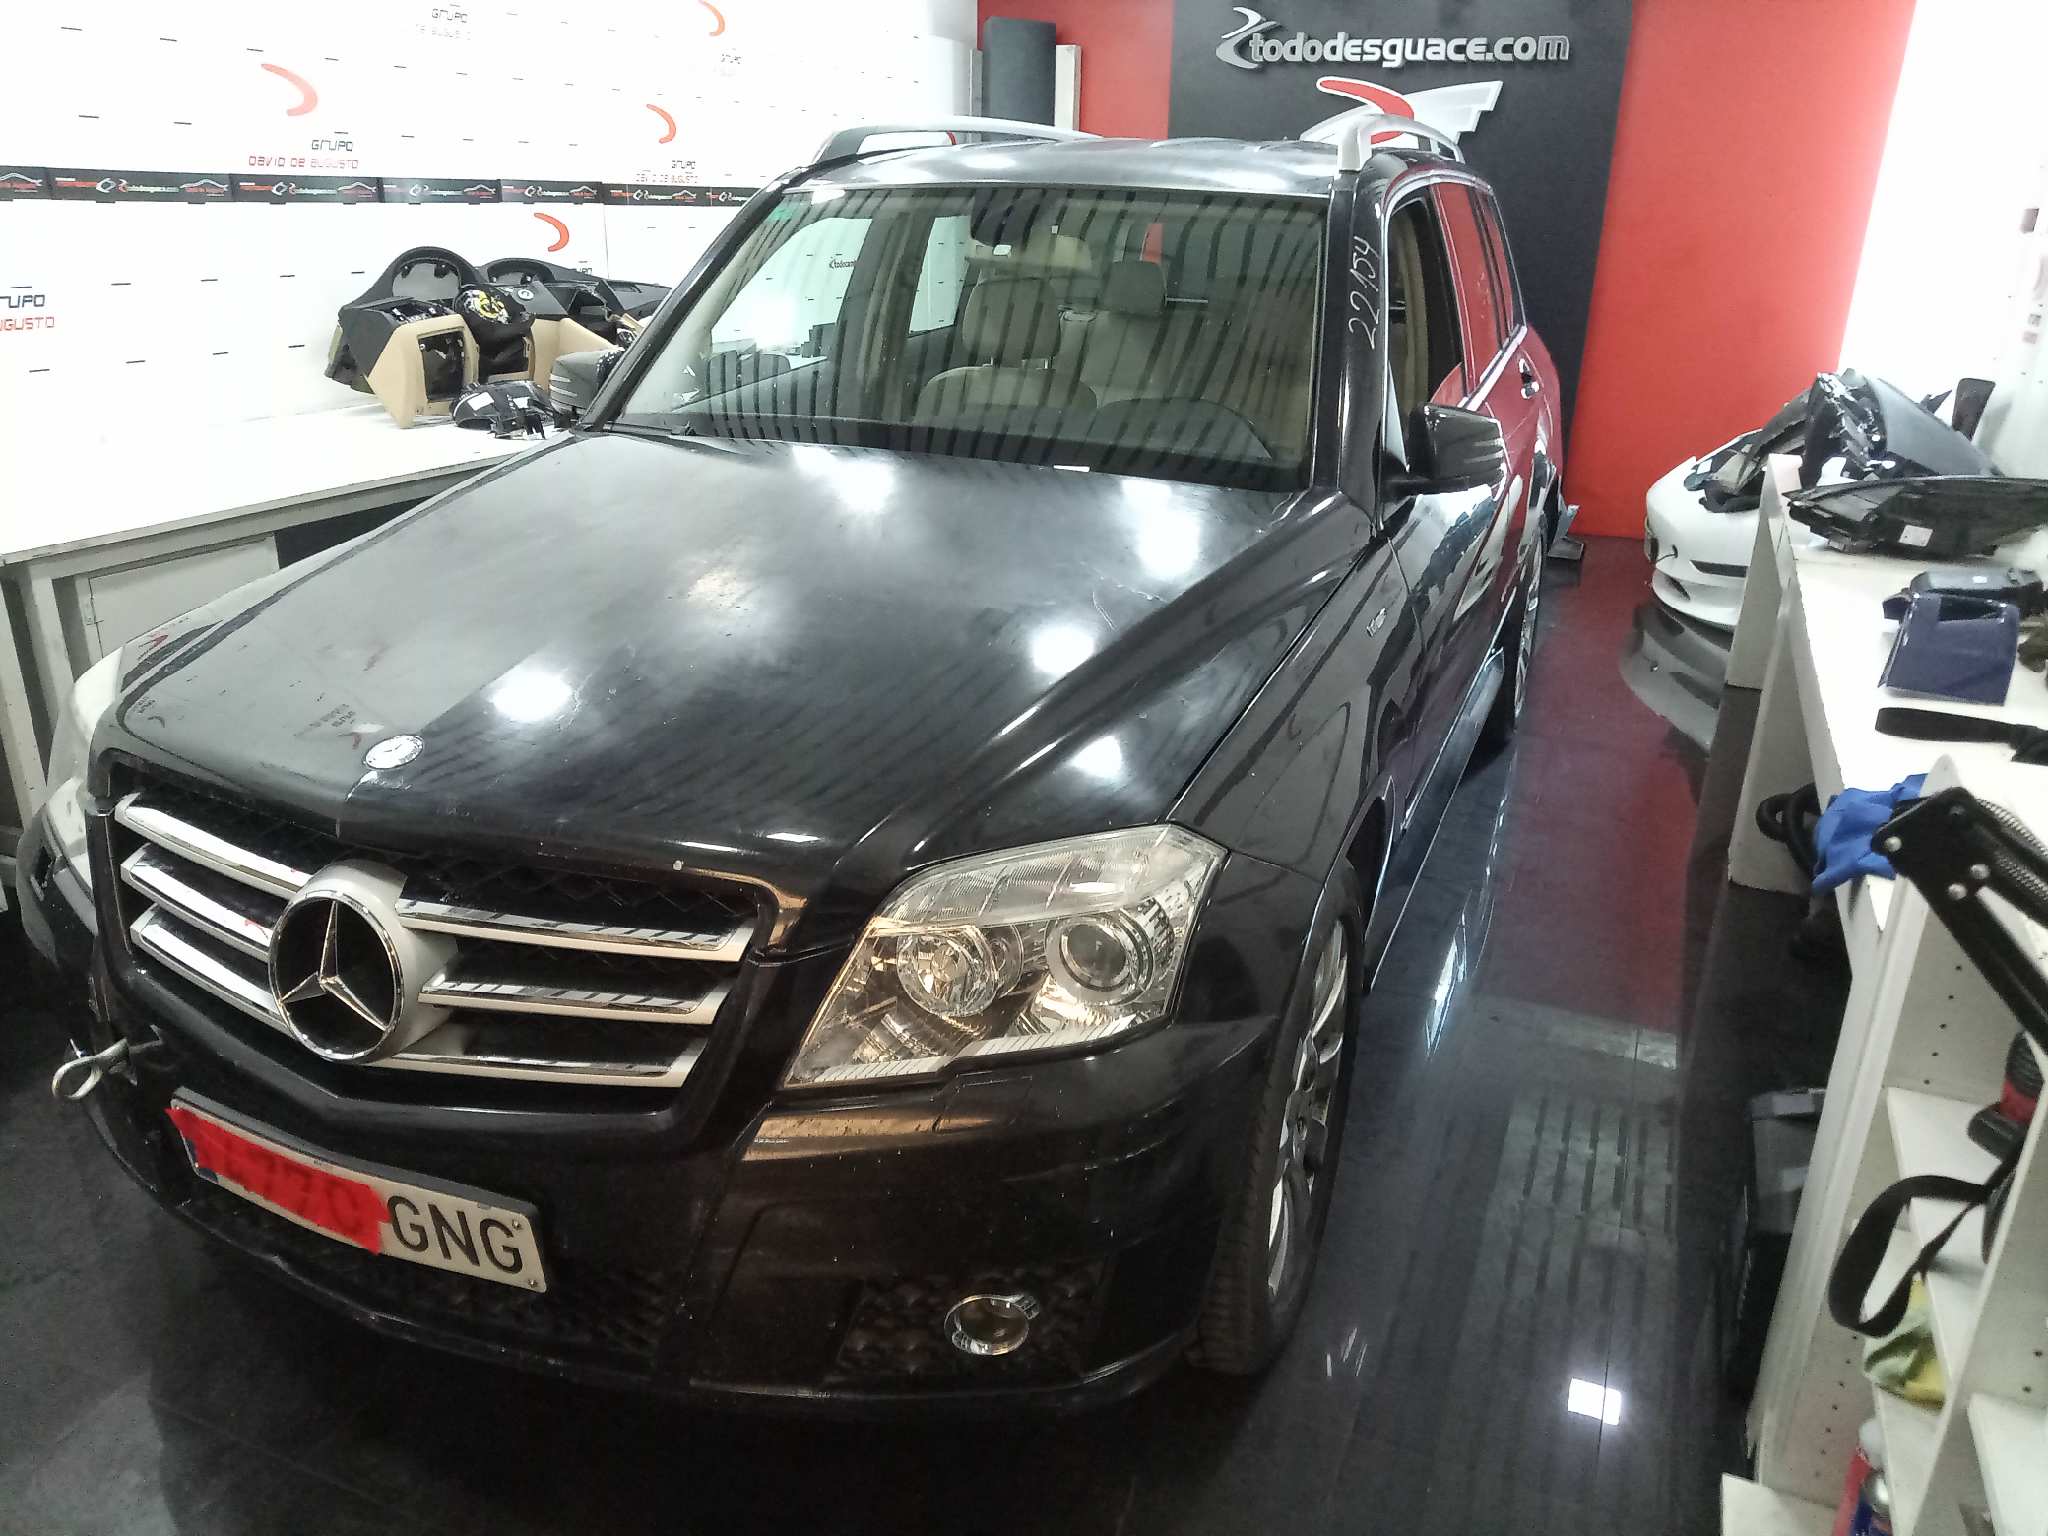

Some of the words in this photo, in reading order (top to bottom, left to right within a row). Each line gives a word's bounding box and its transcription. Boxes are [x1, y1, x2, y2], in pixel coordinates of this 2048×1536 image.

[1249, 31, 1570, 68] tododesguace.com
[0, 316, 55, 331] GUSTO
[386, 1194, 524, 1275] GNG
